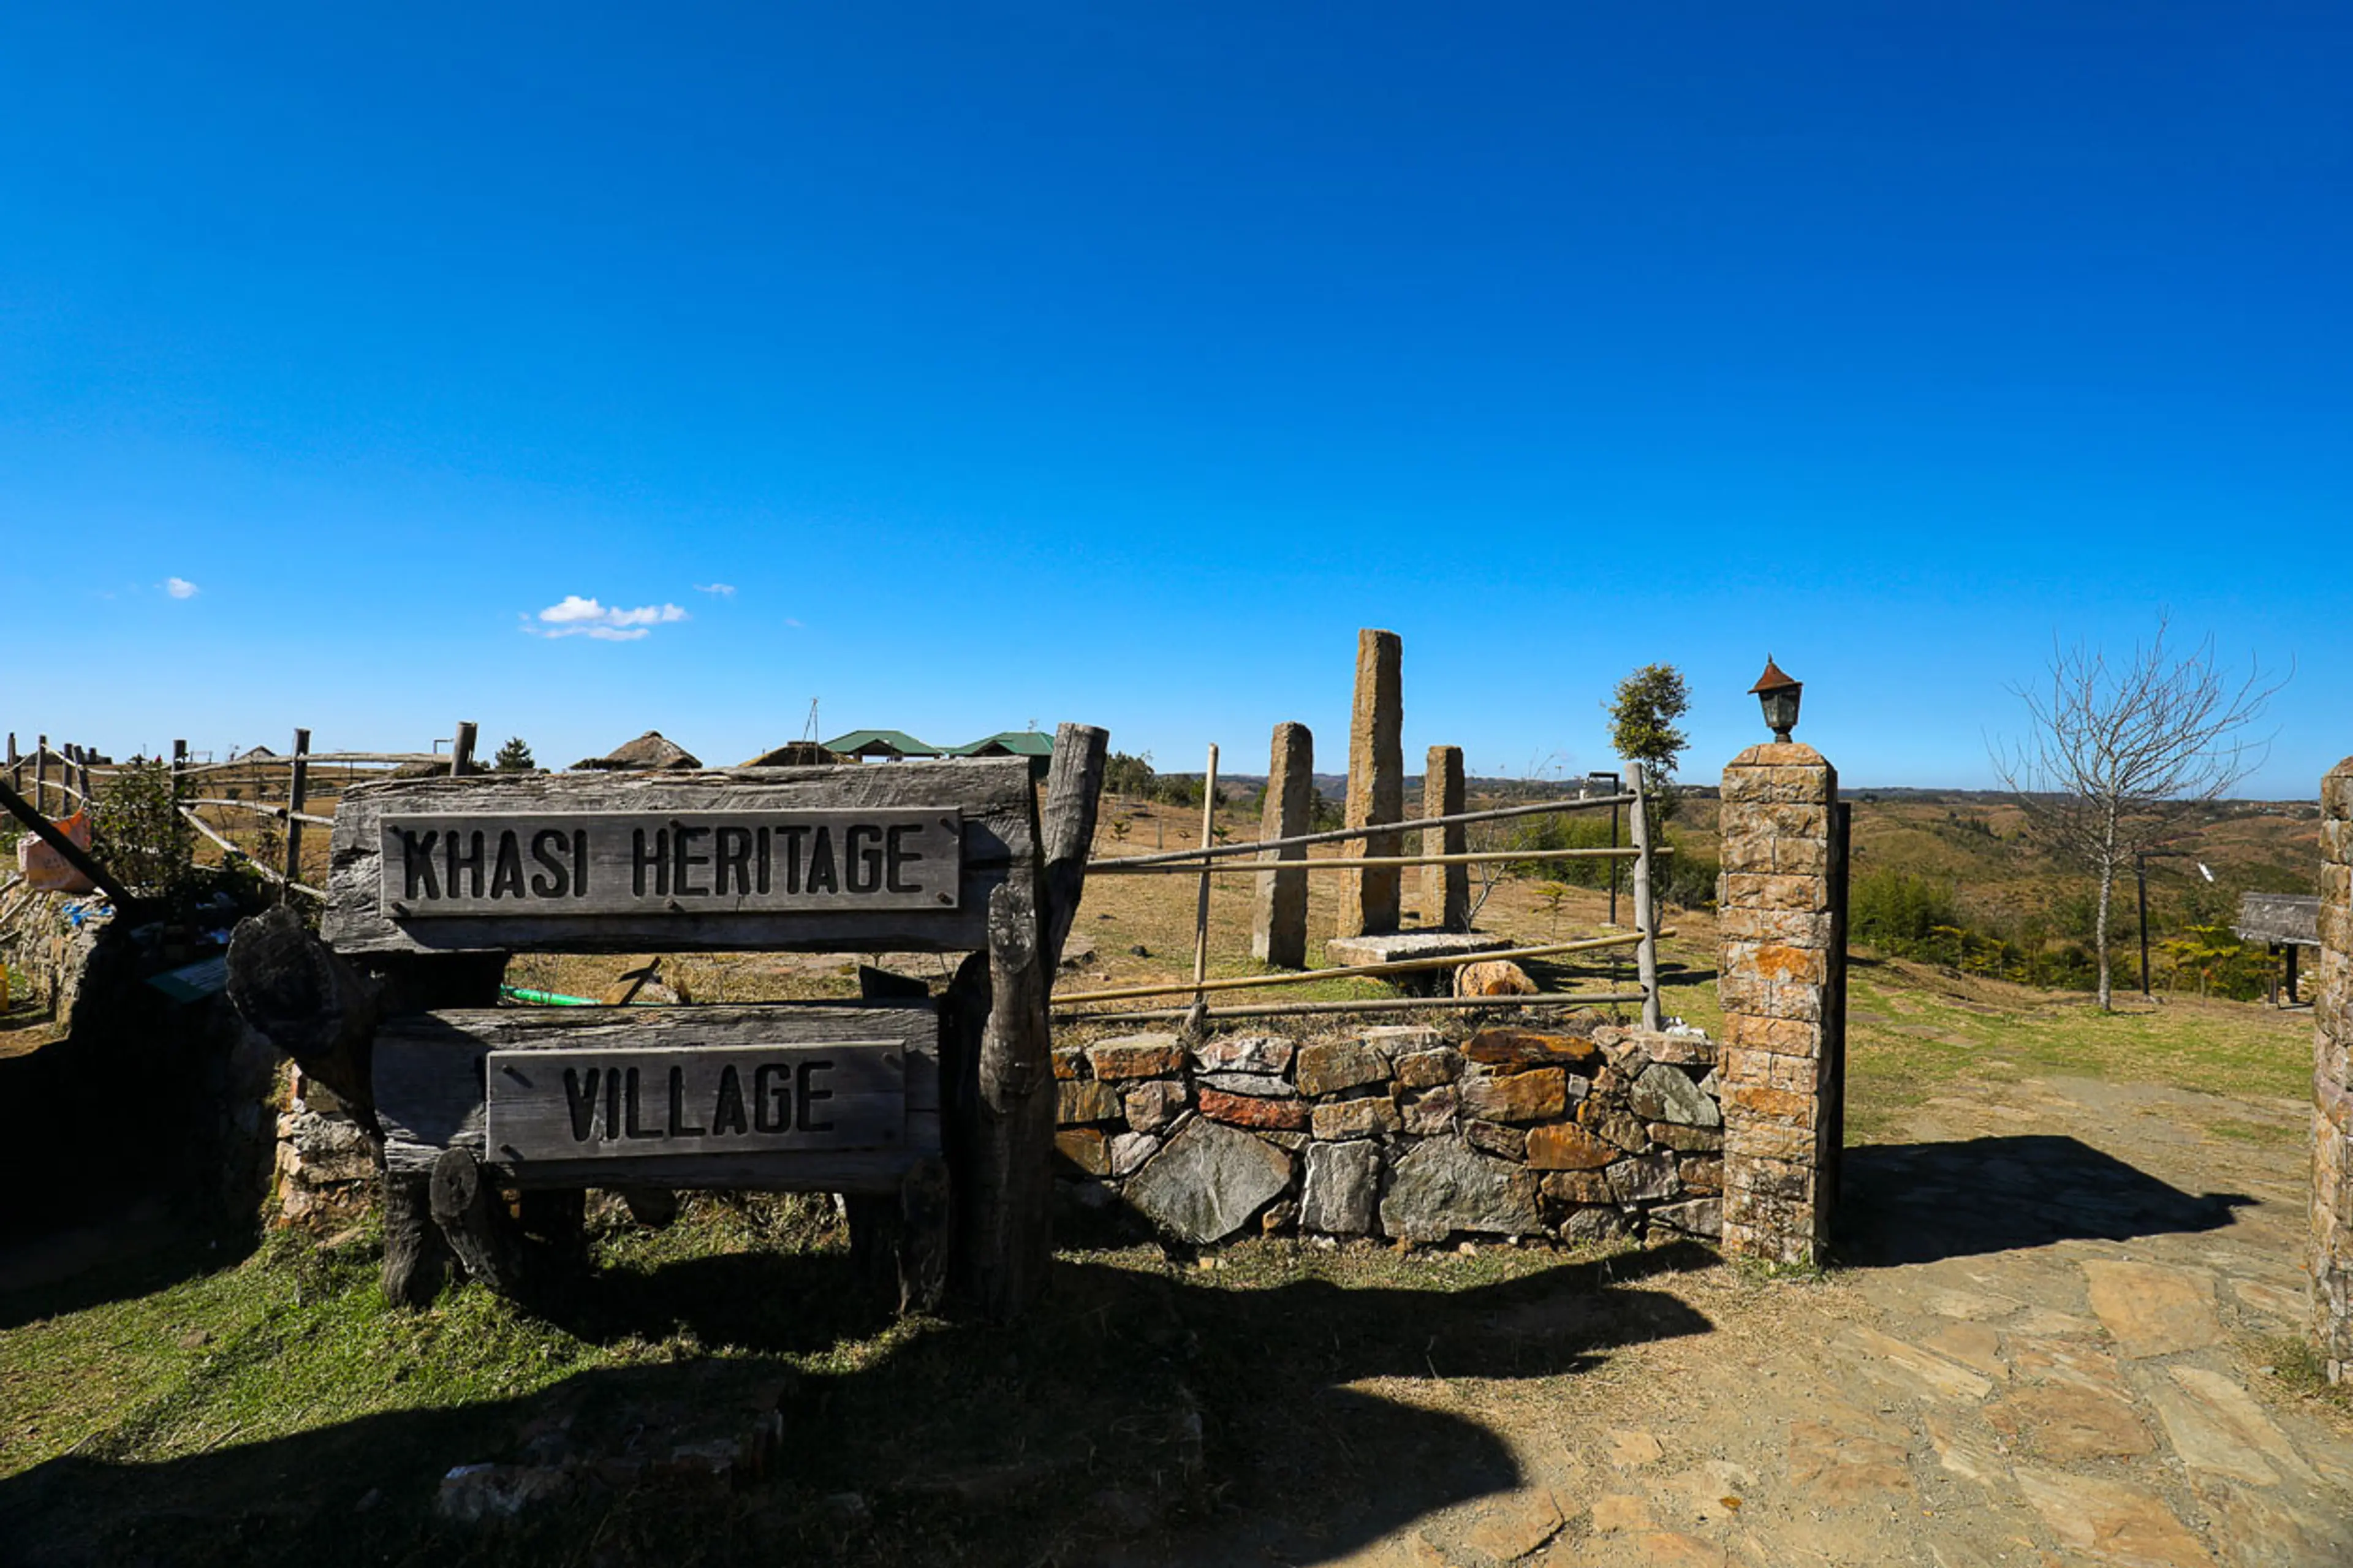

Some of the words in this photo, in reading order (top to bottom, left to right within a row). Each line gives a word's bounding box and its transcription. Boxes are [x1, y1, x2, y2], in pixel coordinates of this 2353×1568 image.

[403, 829, 587, 899] KHASI
[632, 824, 923, 896] HERITAGE
[563, 1061, 835, 1142] VILLAGE
